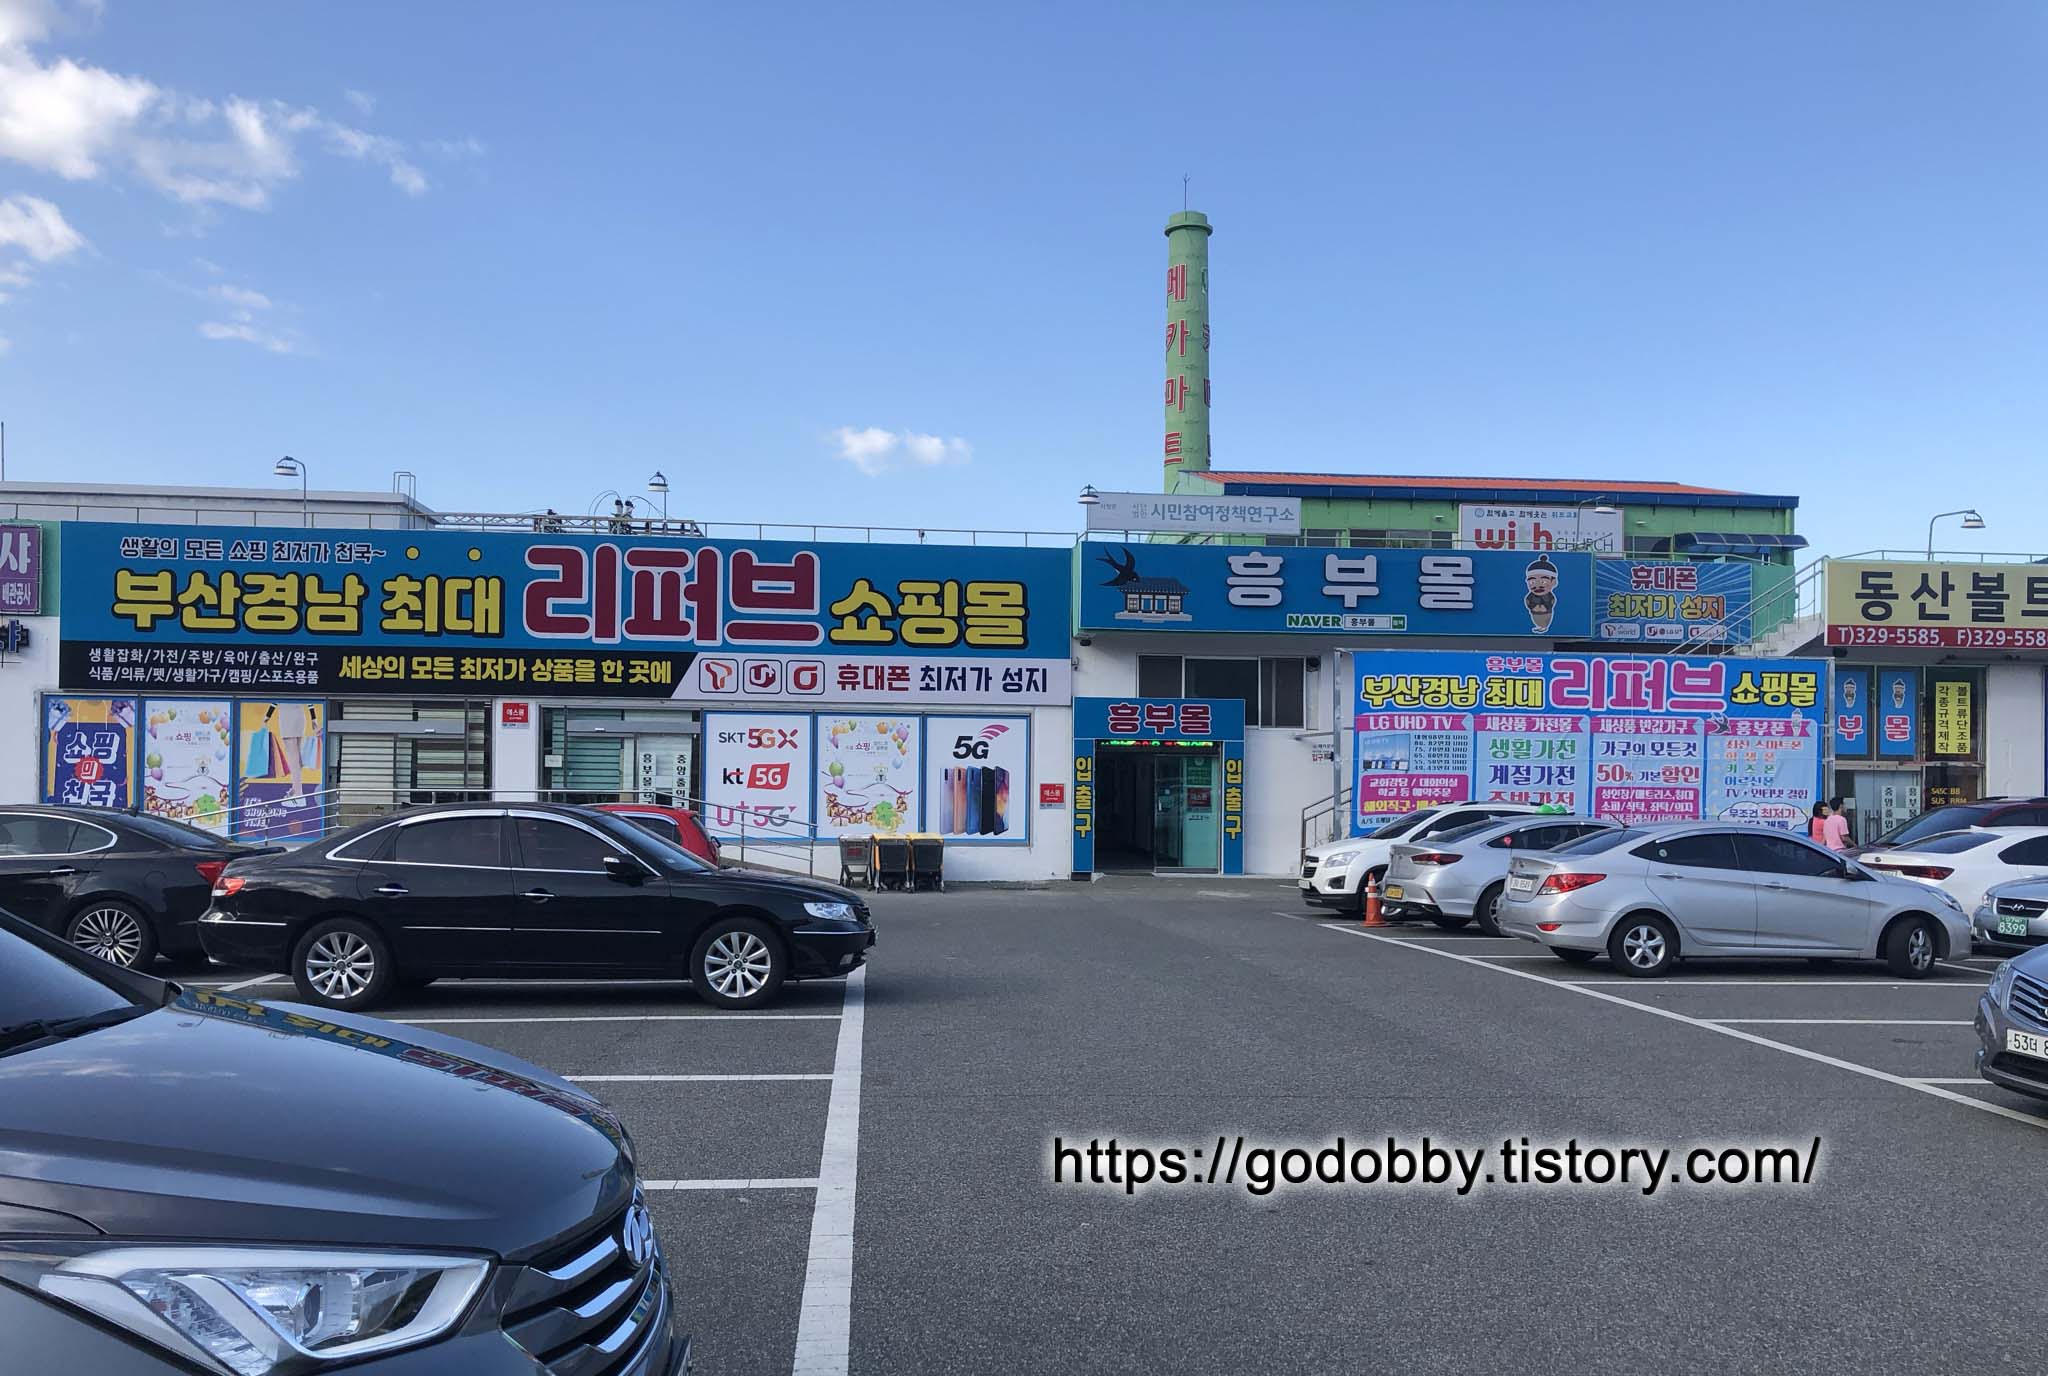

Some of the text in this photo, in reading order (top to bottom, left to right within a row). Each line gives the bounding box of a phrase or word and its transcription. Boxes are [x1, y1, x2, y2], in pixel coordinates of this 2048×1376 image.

[1151, 503, 1295, 523] 시민참여정책연구소
[120, 537, 179, 560] 생활의
[185, 539, 223, 561] 모든
[230, 541, 267, 562] 쇼핑
[273, 541, 330, 564] 최저가
[1226, 551, 1474, 609] 흥부몰
[1631, 565, 1697, 590] 휴대폰
[112, 543, 1029, 648] 부산경남 최대 리퍼브 쇼핑몰
[1855, 570, 2048, 622] 동산볼트
[1609, 593, 1725, 620] 최저가 성지
[1287, 614, 1342, 627] NAVER
[1838, 626, 2048, 647] T)329-5585, F)329-558
[89, 648, 319, 666] 생활잡화/가전/주방/육아/출산/완구
[1486, 656, 1543, 672] 흥부몰
[339, 655, 672, 684] 세상의 모든 최저가 상품을 한 곳에
[836, 664, 1047, 693] 휴대폰 최저가 성지
[1361, 659, 1818, 711] 부산경남 최대 리퍼브 쇼핑몰
[1108, 703, 1212, 734] 흥부몰
[1369, 716, 1453, 730] LG UHD TV
[1486, 717, 1527, 731] 새상품
[1600, 718, 1688, 735] 새상품 반값가구
[1736, 721, 1785, 736] 흥부폰
[1838, 715, 1912, 742] 부 몰
[175, 732, 192, 741] 쇼핑
[718, 728, 798, 749] SKT 5GX
[855, 742, 871, 751] 쇼핑
[64, 732, 120, 764] 쇼핑
[952, 736, 990, 759] 5G
[1488, 738, 1576, 760] 생활가전
[1600, 741, 1697, 757] 가구의 모든것
[81, 761, 98, 779] 의
[722, 767, 782, 785] kt 5G
[1488, 764, 1576, 786] 계절가전
[1597, 764, 1633, 782] 50%
[63, 778, 116, 807] 천국
[1075, 757, 1092, 838] 입출구
[1225, 759, 1242, 840] 입출구
[1729, 808, 1796, 819] 무조건 최저가
[2000, 922, 2025, 934] 8399
[2014, 1033, 2037, 1052] 53더
